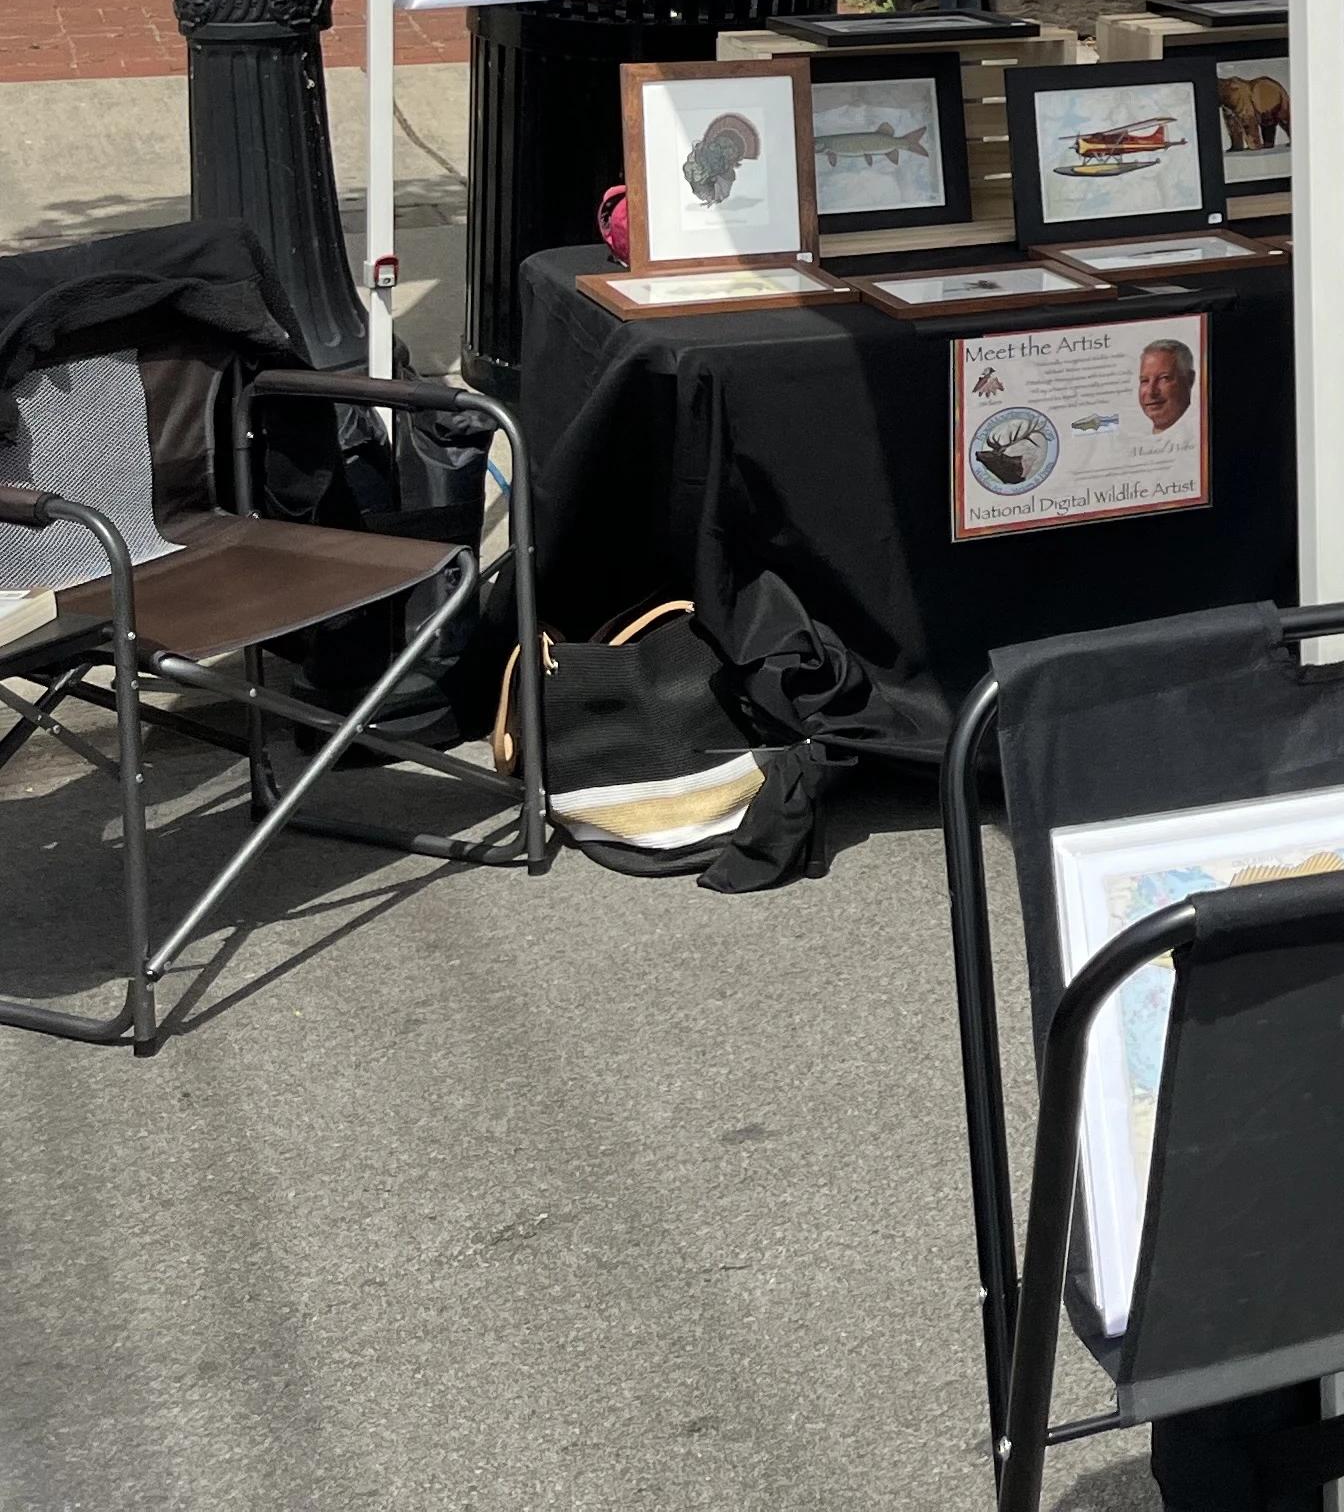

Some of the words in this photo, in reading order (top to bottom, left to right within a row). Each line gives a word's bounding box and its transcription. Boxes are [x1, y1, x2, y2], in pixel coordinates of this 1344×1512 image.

[965, 343, 1016, 363] Meet
[1020, 335, 1052, 356] the
[1055, 334, 1111, 354] Artist
[969, 495, 1036, 522] National
[1039, 488, 1091, 515] Digital
[1093, 481, 1149, 504] Wildlife
[1152, 479, 1197, 496] Artist
